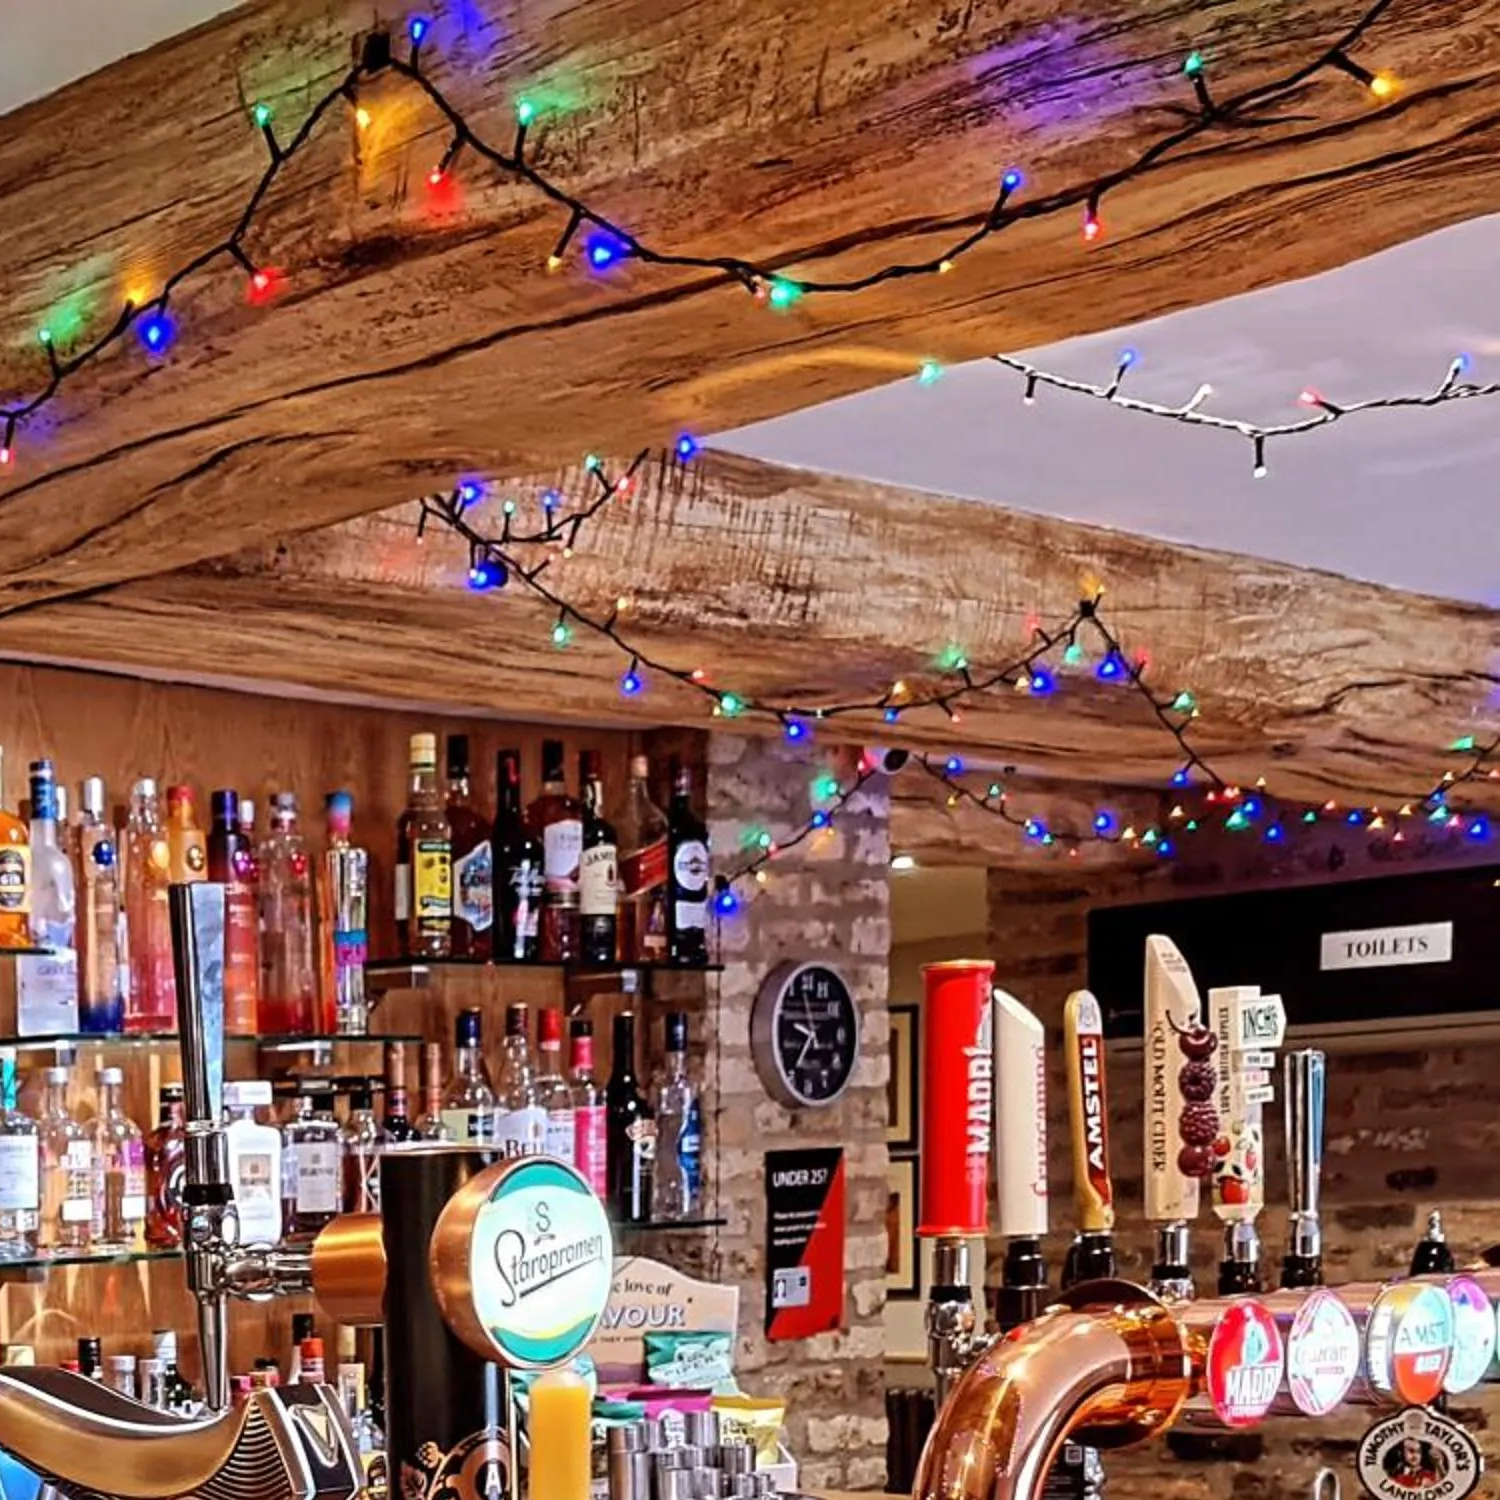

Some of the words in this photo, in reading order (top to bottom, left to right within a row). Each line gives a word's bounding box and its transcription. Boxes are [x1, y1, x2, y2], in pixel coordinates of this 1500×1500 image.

[1342, 936, 1429, 960] TOILETS
[1081, 1037, 1105, 1171] AMSTEL
[772, 1170, 809, 1188] UNDER
[601, 1304, 686, 1329] VOUR
[1364, 1421, 1405, 1467] TIMOTHY
[1423, 1421, 1471, 1473] TAYLOR'S
